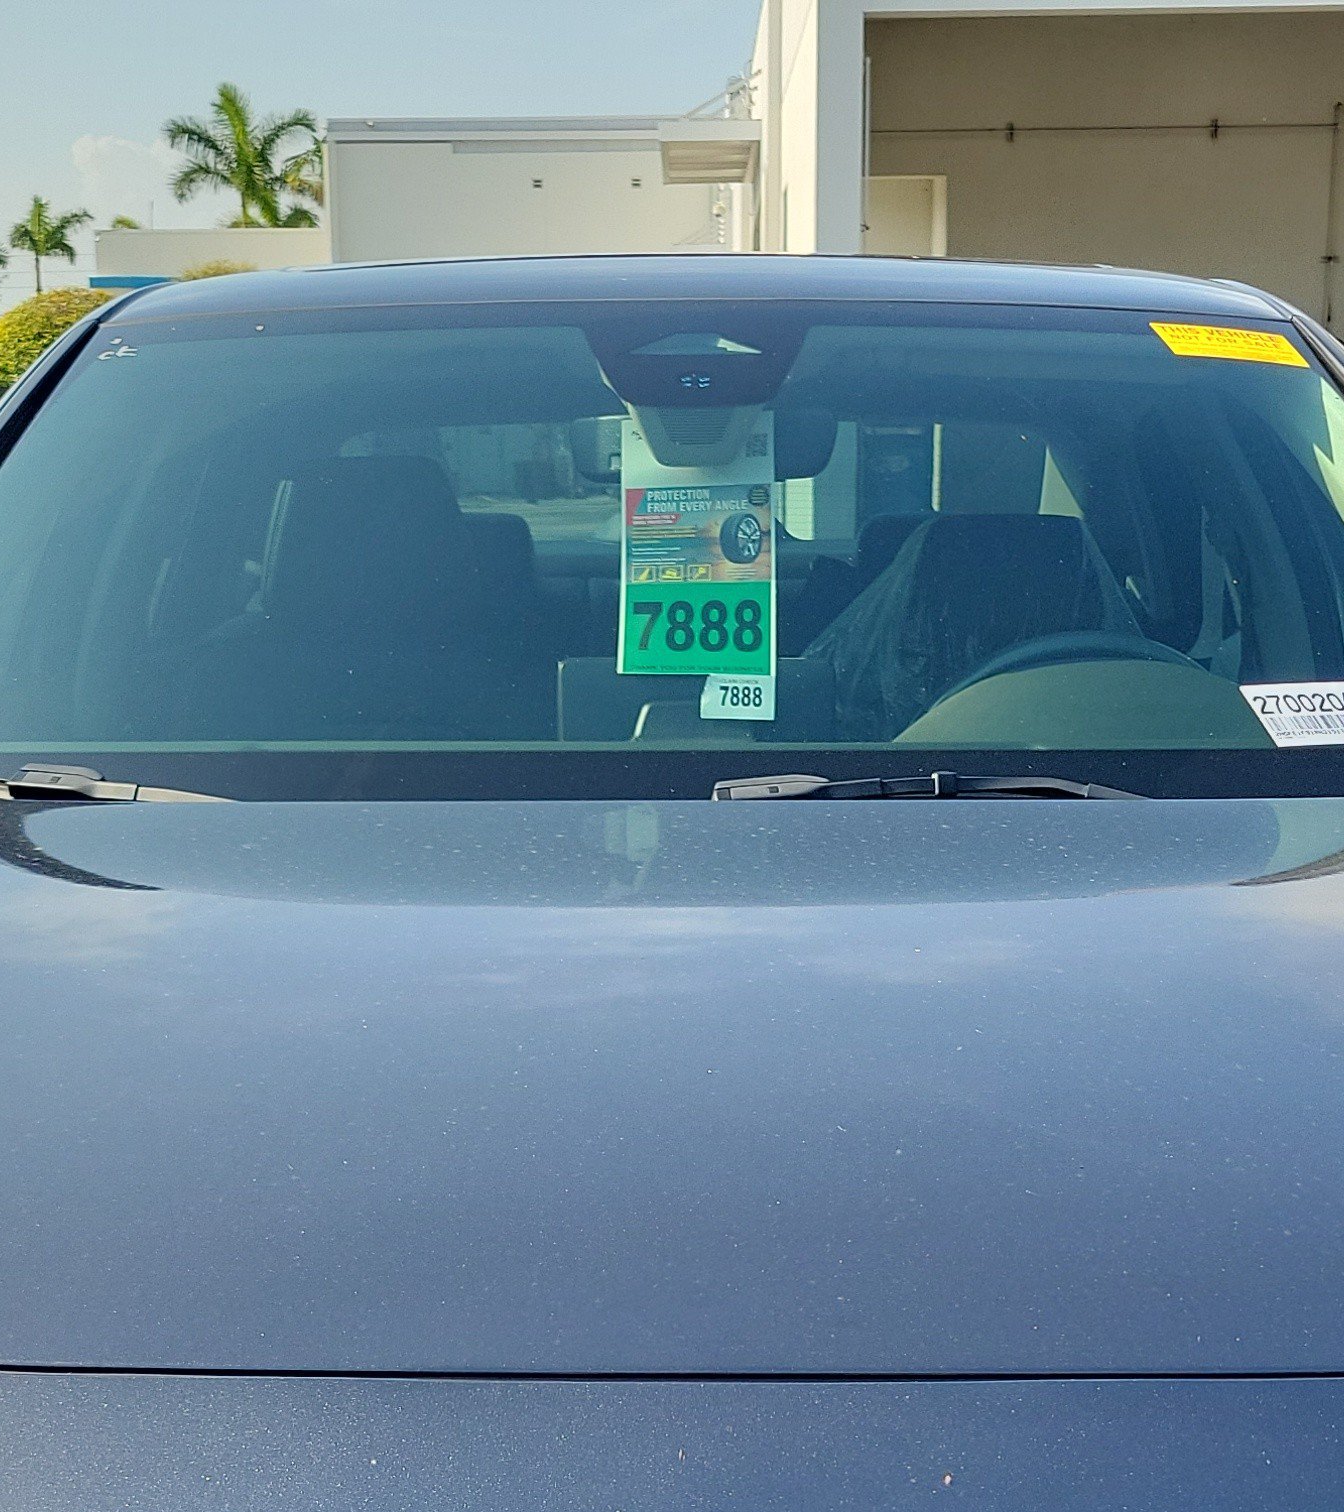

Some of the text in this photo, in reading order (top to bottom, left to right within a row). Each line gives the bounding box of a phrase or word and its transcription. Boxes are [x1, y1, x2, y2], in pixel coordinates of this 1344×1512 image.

[1160, 325, 1280, 344] THIS VEHICLE
[647, 489, 710, 501] PROTECTION
[647, 500, 748, 513] FROM EVERY ANGLE
[632, 600, 763, 652] 7888
[719, 686, 763, 707] 7888
